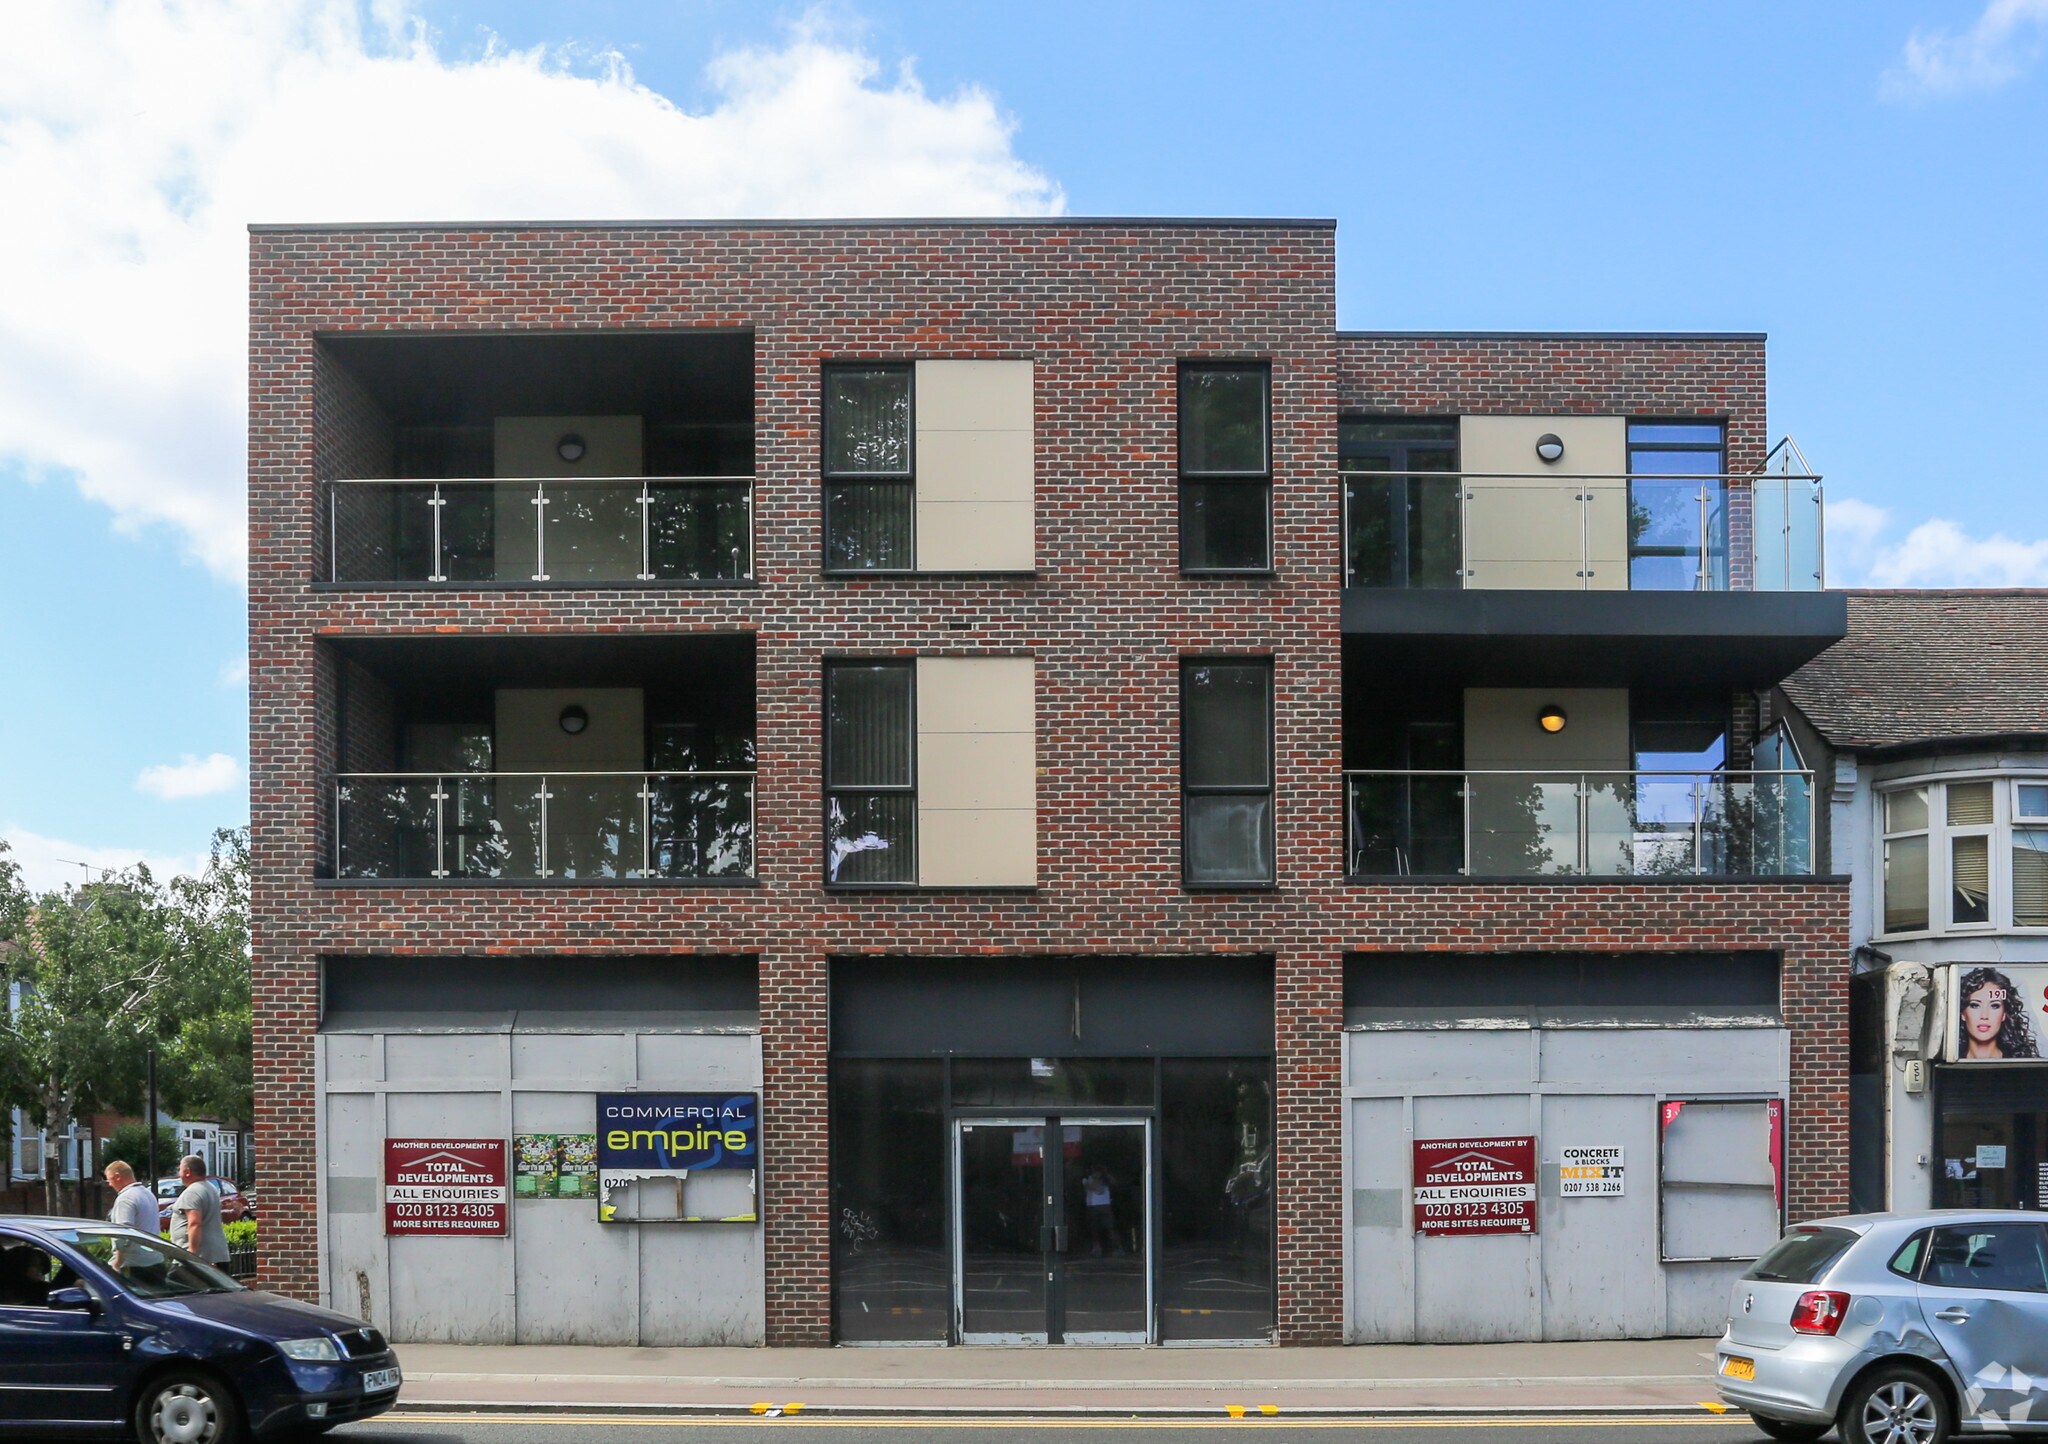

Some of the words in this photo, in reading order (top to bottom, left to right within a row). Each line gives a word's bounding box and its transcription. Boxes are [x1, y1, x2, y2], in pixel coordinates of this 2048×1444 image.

[1989, 989, 2007, 1000] 191
[606, 1107, 746, 1118] COMMERCIAL
[1665, 1108, 1672, 1119] 3
[607, 1123, 747, 1158] empire
[1420, 1142, 1458, 1150] ANOTHER
[1459, 1140, 1516, 1149] DEVELOPMENT
[1564, 1149, 1619, 1158] CONCRETE
[425, 1163, 465, 1172] TOTAL
[1454, 1161, 1495, 1172] TOTAL
[1426, 1171, 1523, 1183] DEVELOPMENTS
[1560, 1166, 1625, 1179] MIXIT
[397, 1173, 494, 1184] DEVELOPMENTS
[604, 1178, 627, 1188] 020
[1419, 1190, 1446, 1200] ALL
[1450, 1186, 1527, 1199] ENQUIRIES
[1563, 1183, 1582, 1192] 0207
[1586, 1183, 1600, 1192] 538
[1603, 1183, 1621, 1192] 2266
[393, 1189, 418, 1199] ALL
[422, 1189, 499, 1199] ENQUIRIES
[396, 1204, 422, 1216] 020
[425, 1204, 458, 1217] 8123
[461, 1204, 495, 1217] 4305
[1425, 1204, 1451, 1217] 020
[1454, 1203, 1487, 1216] 8123
[1490, 1202, 1524, 1215] 4305
[392, 1220, 421, 1228] MORE
[422, 1220, 450, 1228] SITES
[451, 1220, 500, 1228] REQUIRED
[1421, 1220, 1450, 1229] MORE
[1451, 1219, 1479, 1228] SITES
[1480, 1218, 1530, 1227] REQUIRED
